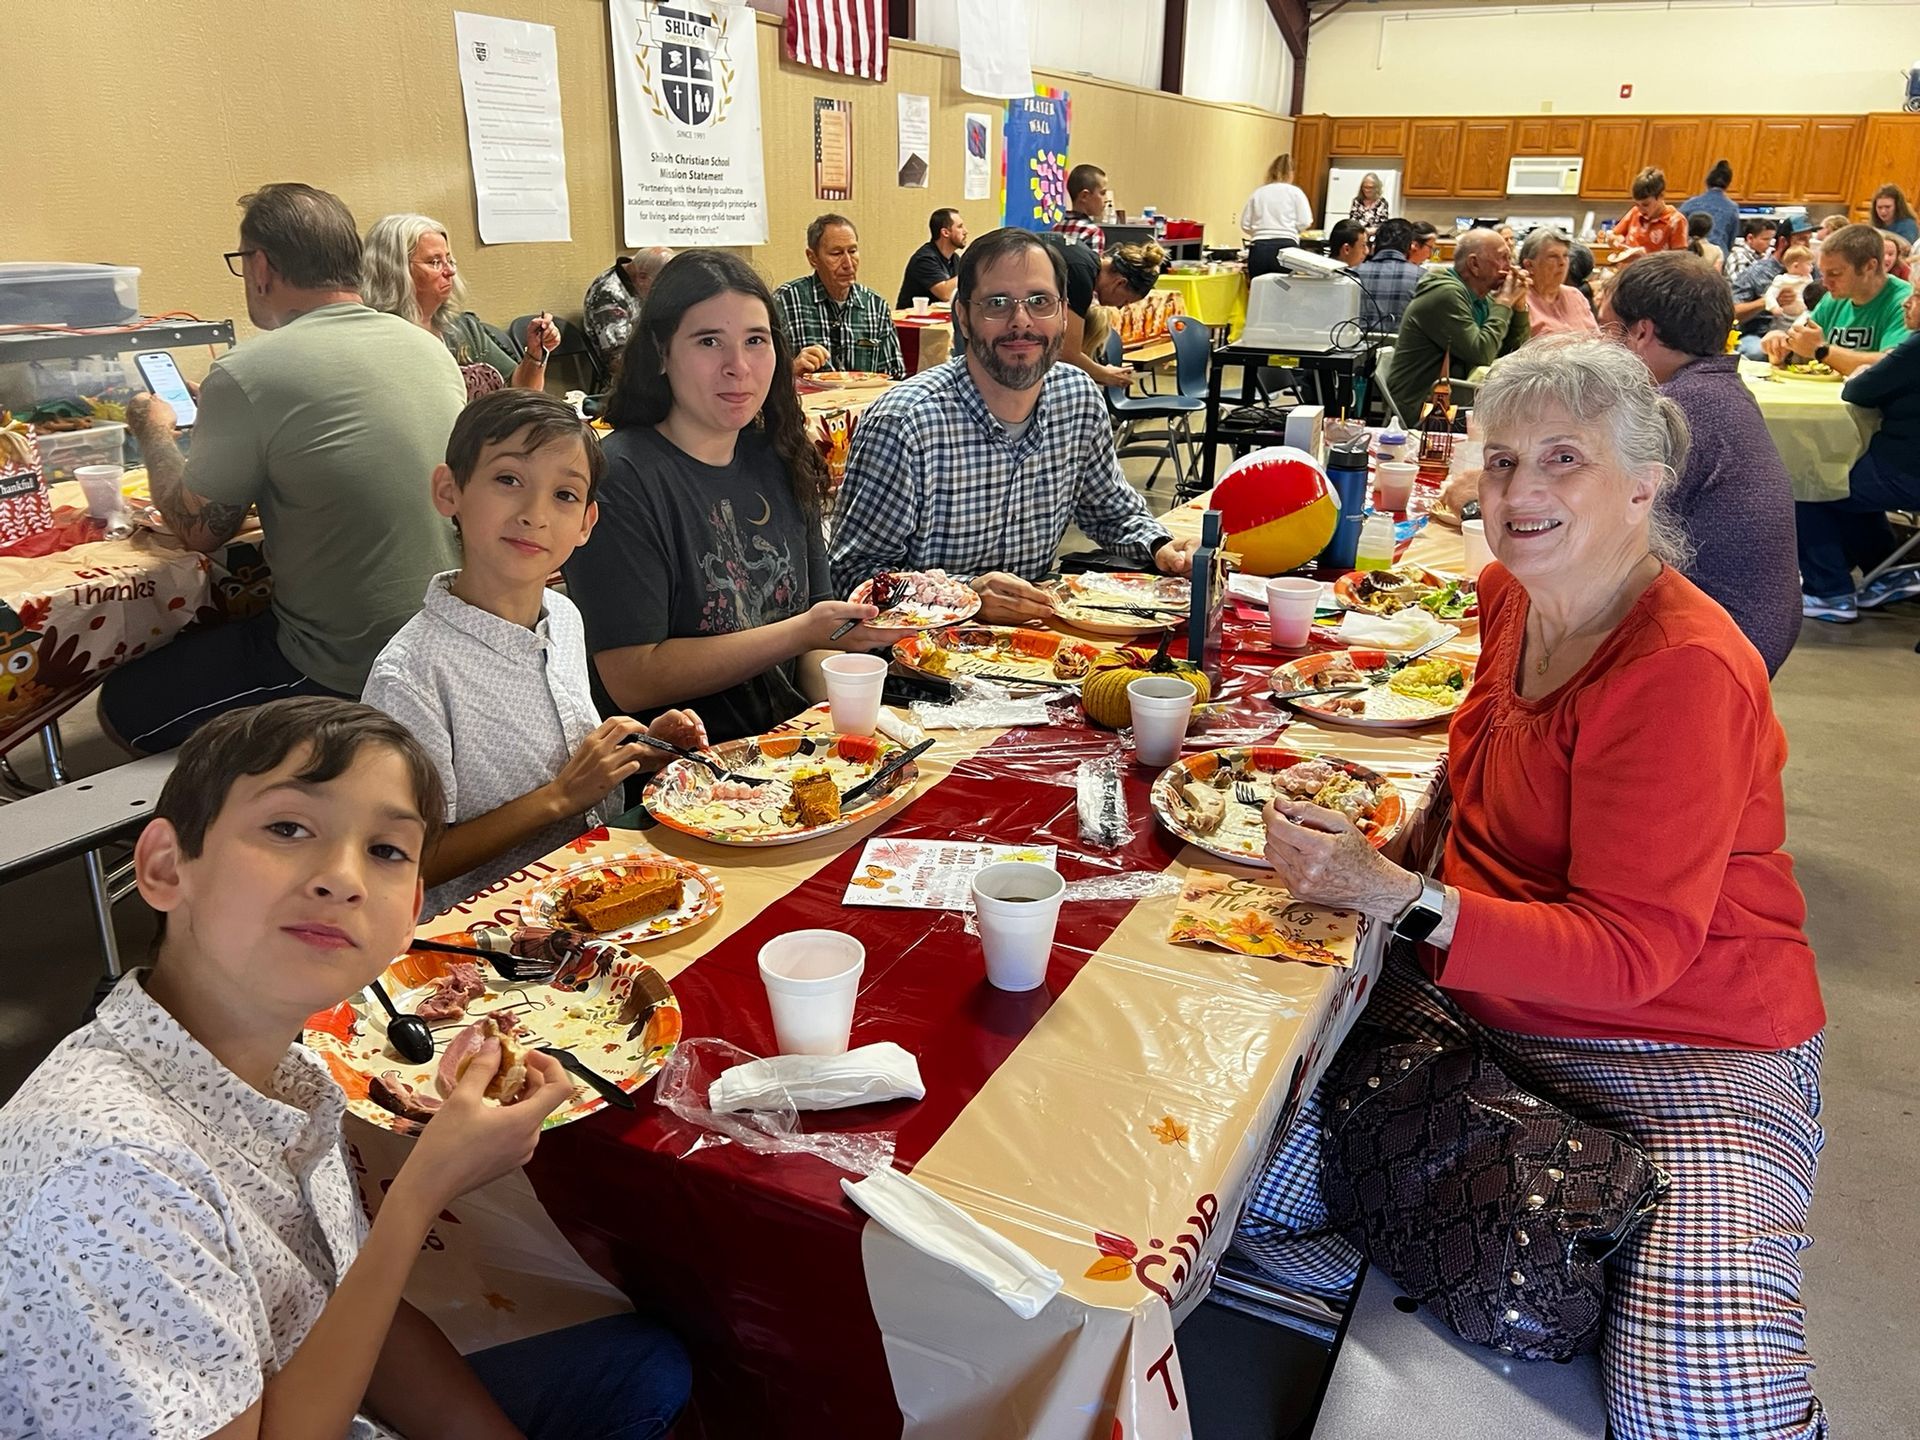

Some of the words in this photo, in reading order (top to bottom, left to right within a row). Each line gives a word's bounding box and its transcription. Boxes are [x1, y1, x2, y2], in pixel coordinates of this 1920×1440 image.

[651, 152, 673, 163] Shiloh
[675, 154, 709, 166] Christian
[711, 156, 730, 167] School
[660, 168, 687, 179] Mission
[689, 170, 723, 181] Statement
[686, 185, 696, 194] the
[697, 185, 713, 196] family
[720, 187, 743, 195] cultivate
[628, 198, 654, 206] academic
[687, 200, 711, 209] integrate
[712, 200, 727, 209] godly
[729, 201, 757, 210] principles
[640, 211, 648, 220] for
[668, 213, 679, 221] and
[696, 214, 710, 222] every
[711, 213, 725, 221] child
[669, 226, 693, 236] maturity
[0, 478, 35, 495] hankful
[65, 576, 156, 606] Thanks
[1208, 889, 1320, 926] Thanks
